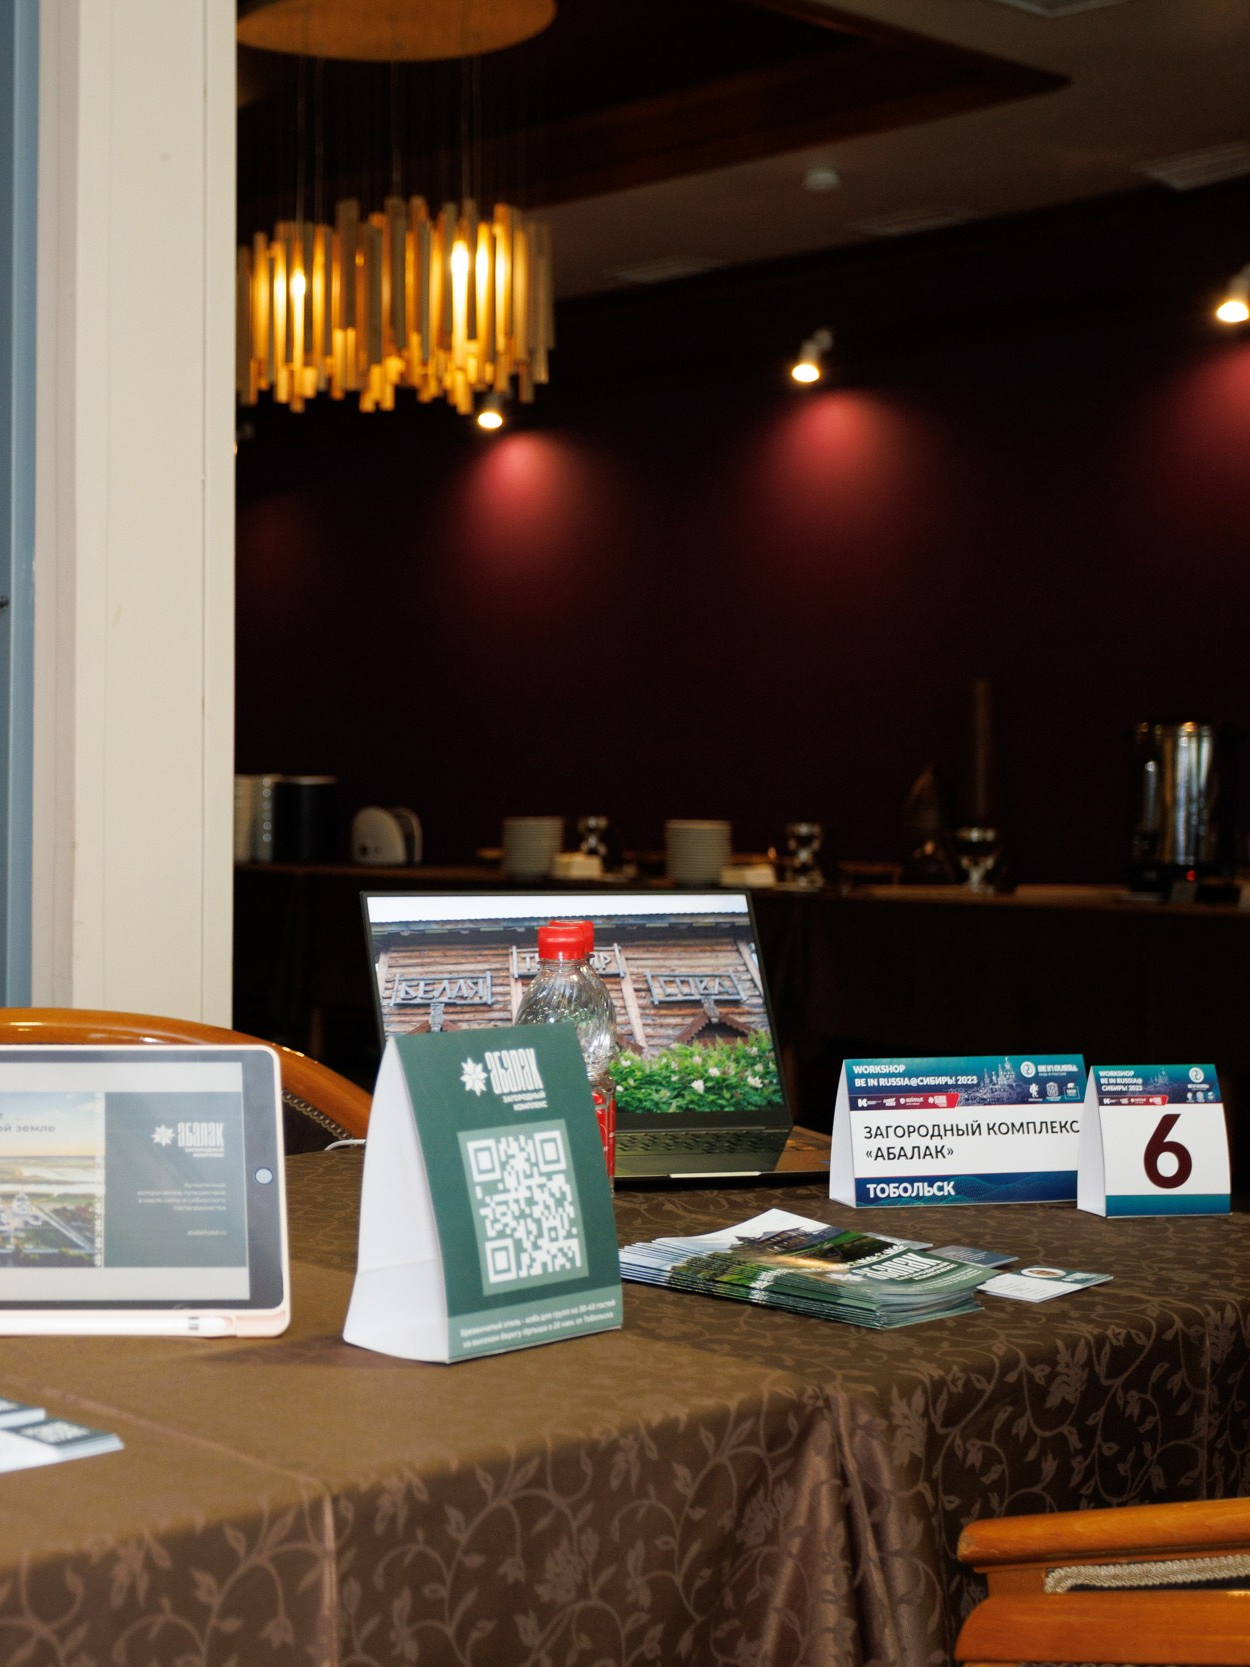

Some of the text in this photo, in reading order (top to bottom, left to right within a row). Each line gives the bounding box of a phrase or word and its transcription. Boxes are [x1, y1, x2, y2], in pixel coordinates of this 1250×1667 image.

[400, 978, 485, 1002] БЕЛАЯ
[659, 976, 729, 997] СОВА
[852, 1065, 906, 1074] WORKSHOP
[854, 1078, 867, 1087] BE
[867, 1078, 878, 1087] IN
[957, 1076, 978, 1085] 2023
[15, 1124, 56, 1133] земле
[863, 1117, 1081, 1141] ЗАГОРОДНЫЙ КОМПЛЕКС
[865, 1144, 955, 1163] «АБАЛАК»
[1143, 1112, 1193, 1189] 6
[866, 1180, 956, 1199] ТОБОЛЬСК
